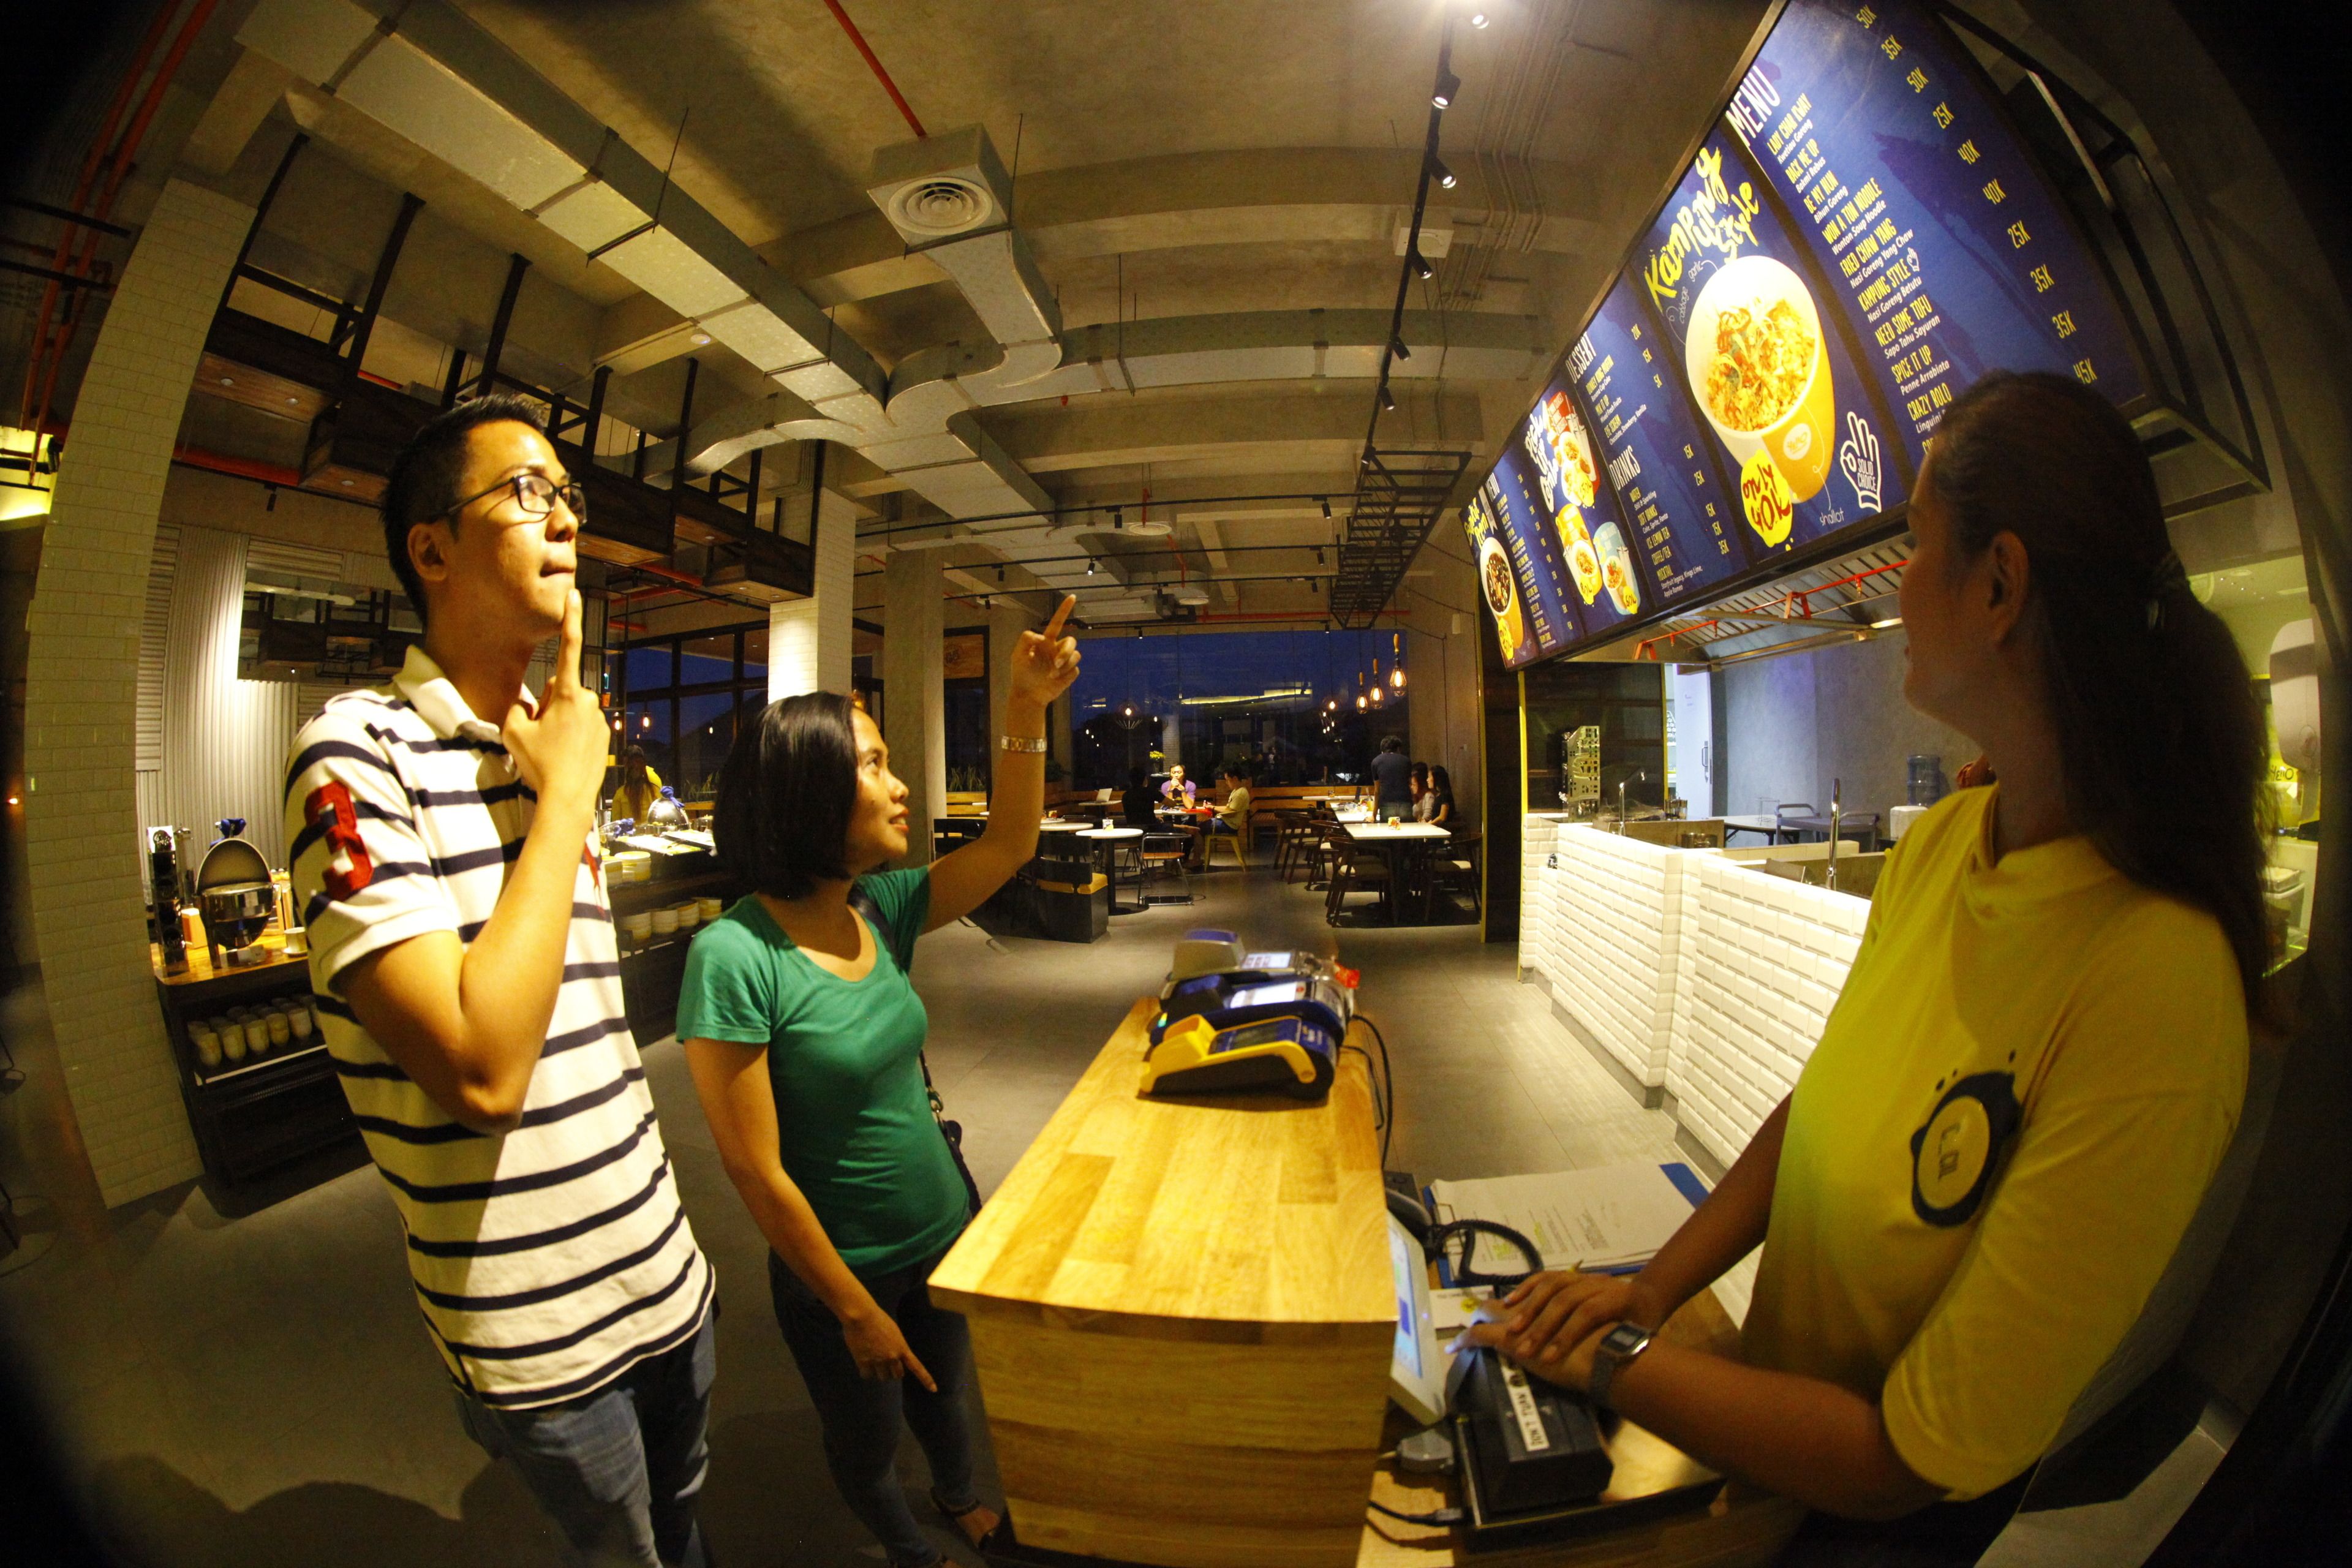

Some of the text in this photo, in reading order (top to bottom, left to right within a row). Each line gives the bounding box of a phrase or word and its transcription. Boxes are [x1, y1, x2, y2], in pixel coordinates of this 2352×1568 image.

[1855, 4, 1877, 29] 50K
[1880, 34, 1902, 61] 35K
[1906, 66, 1929, 93] 50K
[1725, 65, 1781, 147] MENU
[1932, 101, 1954, 129] 25K
[1766, 130, 1784, 156] LADY
[1791, 92, 1812, 122] KWAY
[1777, 119, 1814, 165] Kwetiau Goreng
[1797, 148, 1813, 168] ME
[1806, 138, 1820, 157] UP
[1957, 138, 1981, 165] 40K
[1795, 156, 1826, 194] Bakmi Rebus
[1803, 195, 1817, 214] BE
[1811, 184, 1825, 205] MY
[1814, 186, 1849, 224] Bihun Goreng
[1982, 178, 2007, 206] 40K
[1822, 176, 1883, 245] WON A TON NOODLE
[1831, 200, 1887, 255] Wonton Soup Noodle
[2007, 220, 2031, 249] 25K
[1839, 217, 1898, 279] FRIED CHAW YANG
[1849, 228, 1914, 290] Nasi Goreng Yang Chaw
[1856, 258, 1912, 312] KAMPUNG STYLE
[2029, 263, 2055, 293] 35K
[1867, 276, 1923, 323] Nasi Goreng Betutu
[1874, 294, 1933, 347] NEED SOME TOFU
[2051, 310, 2077, 339] 35K
[1884, 315, 1941, 360] Sapo Tahu Sayuran
[1565, 331, 1597, 384] DESSERT
[1642, 347, 1653, 363] 15K
[1891, 344, 1932, 384] SPICE IT UP
[1653, 374, 1663, 388] 5K
[1900, 360, 1950, 396] Penne Arrabiata
[2073, 358, 2098, 385] 45K
[1906, 382, 1953, 421] CRAZY BOLO
[1915, 412, 1942, 434] Linguini
[1683, 443, 1694, 459] 15K
[1609, 445, 1641, 491] DRINKS
[1694, 470, 1705, 487] 25K
[1857, 458, 1874, 476] SOLID
[1857, 472, 1877, 492] CHOICE
[1705, 502, 1716, 518] 15K
[1819, 507, 1845, 527] shallot
[1660, 526, 1671, 540] TEA
[1711, 521, 1723, 536] 15K
[1717, 538, 1730, 555] 35K
[304, 780, 374, 901] 3
